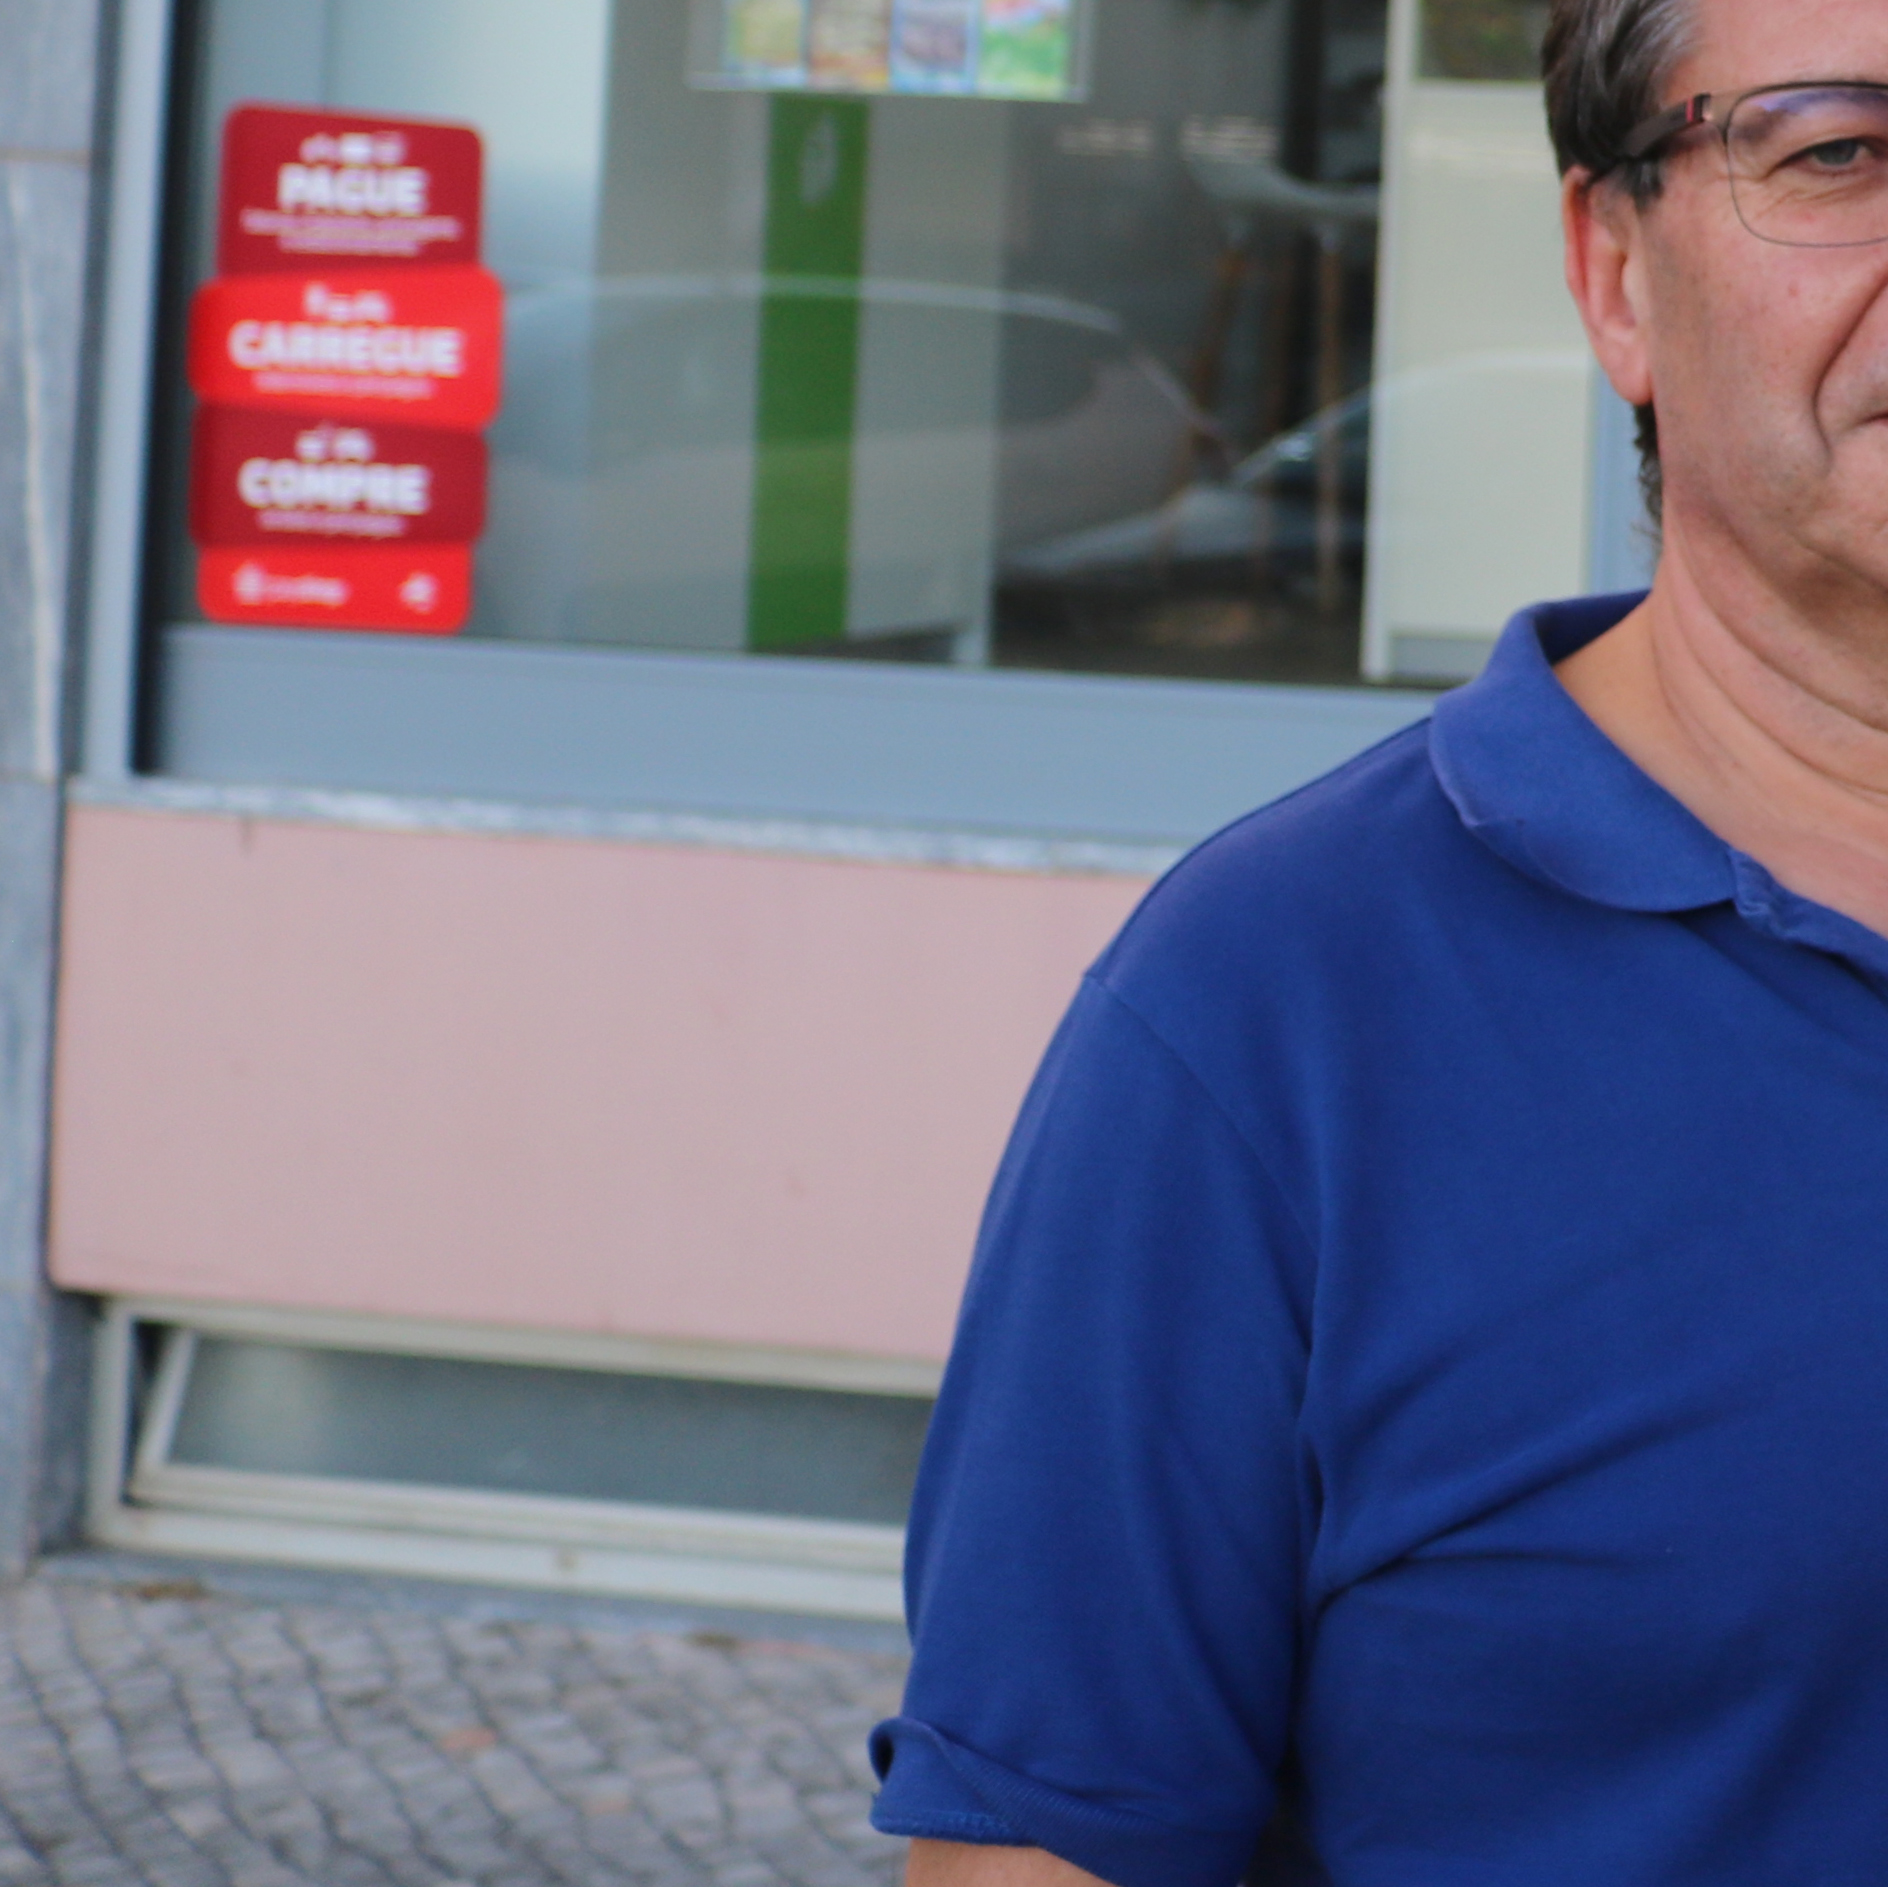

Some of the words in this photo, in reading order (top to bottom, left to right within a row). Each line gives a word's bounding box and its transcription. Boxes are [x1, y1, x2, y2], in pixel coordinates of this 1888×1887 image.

[279, 163, 429, 217] PAGUE
[227, 320, 466, 378] CARREGUE
[237, 458, 431, 515] COMPRE
